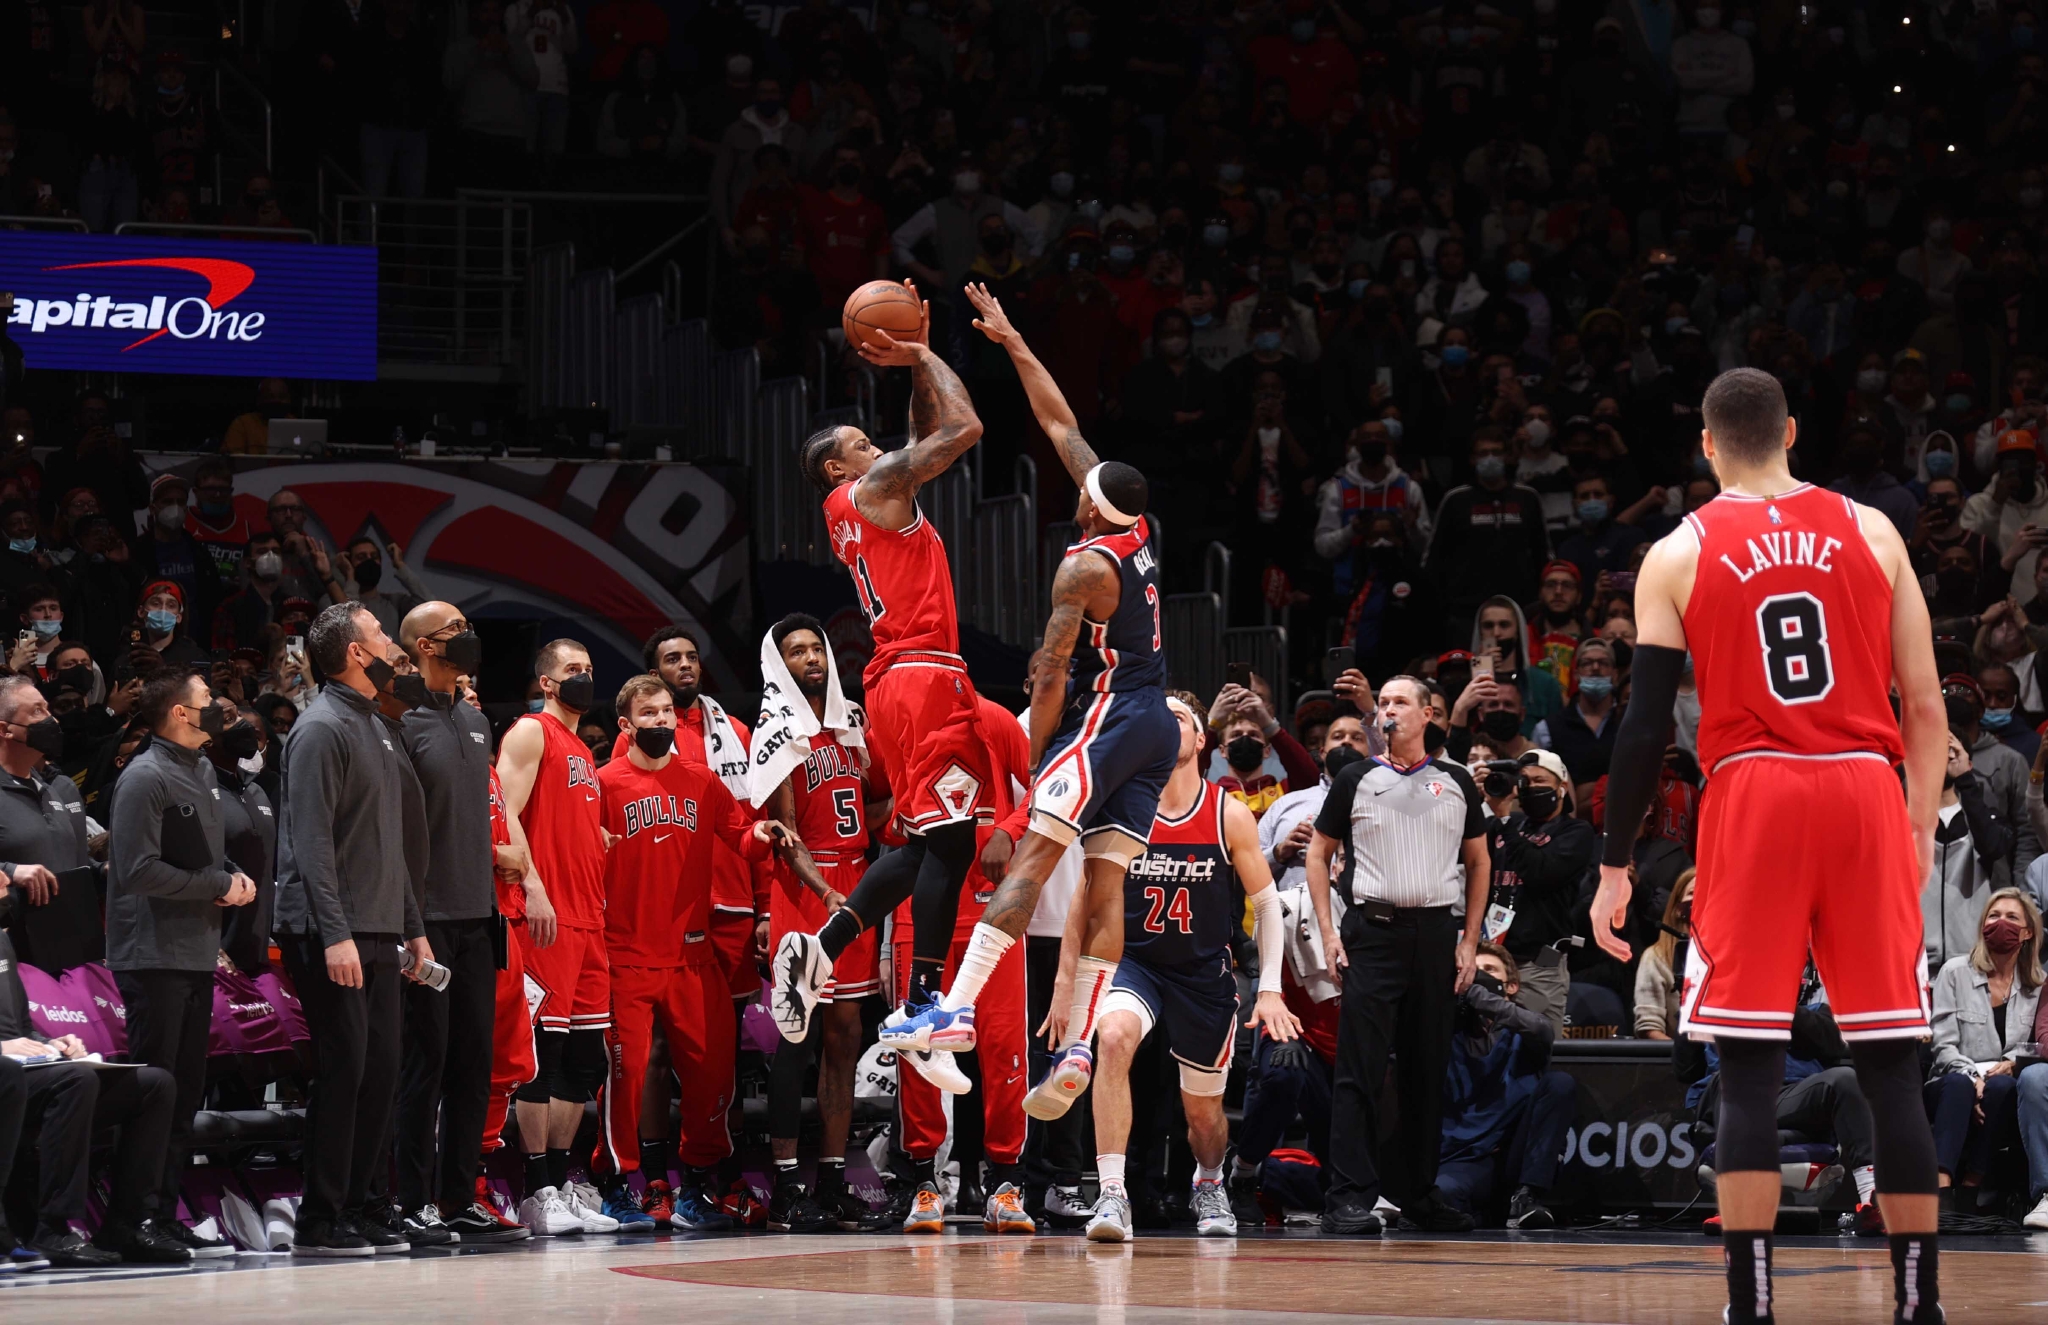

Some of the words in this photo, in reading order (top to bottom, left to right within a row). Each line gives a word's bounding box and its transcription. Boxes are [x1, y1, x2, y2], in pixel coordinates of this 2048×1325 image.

[1133, 545, 1156, 577] BEAL
[1719, 531, 1843, 583] LAVINE
[1145, 582, 1162, 653] 3
[1755, 590, 1835, 706] 8
[566, 754, 601, 792] BUL
[804, 744, 862, 794] BULL
[623, 795, 698, 839] BULLS
[832, 787, 861, 838] 5
[1129, 851, 1216, 877] district
[1143, 886, 1194, 934] 24
[41, 1004, 89, 1024] leidos
[856, 1184, 889, 1204] leidos
